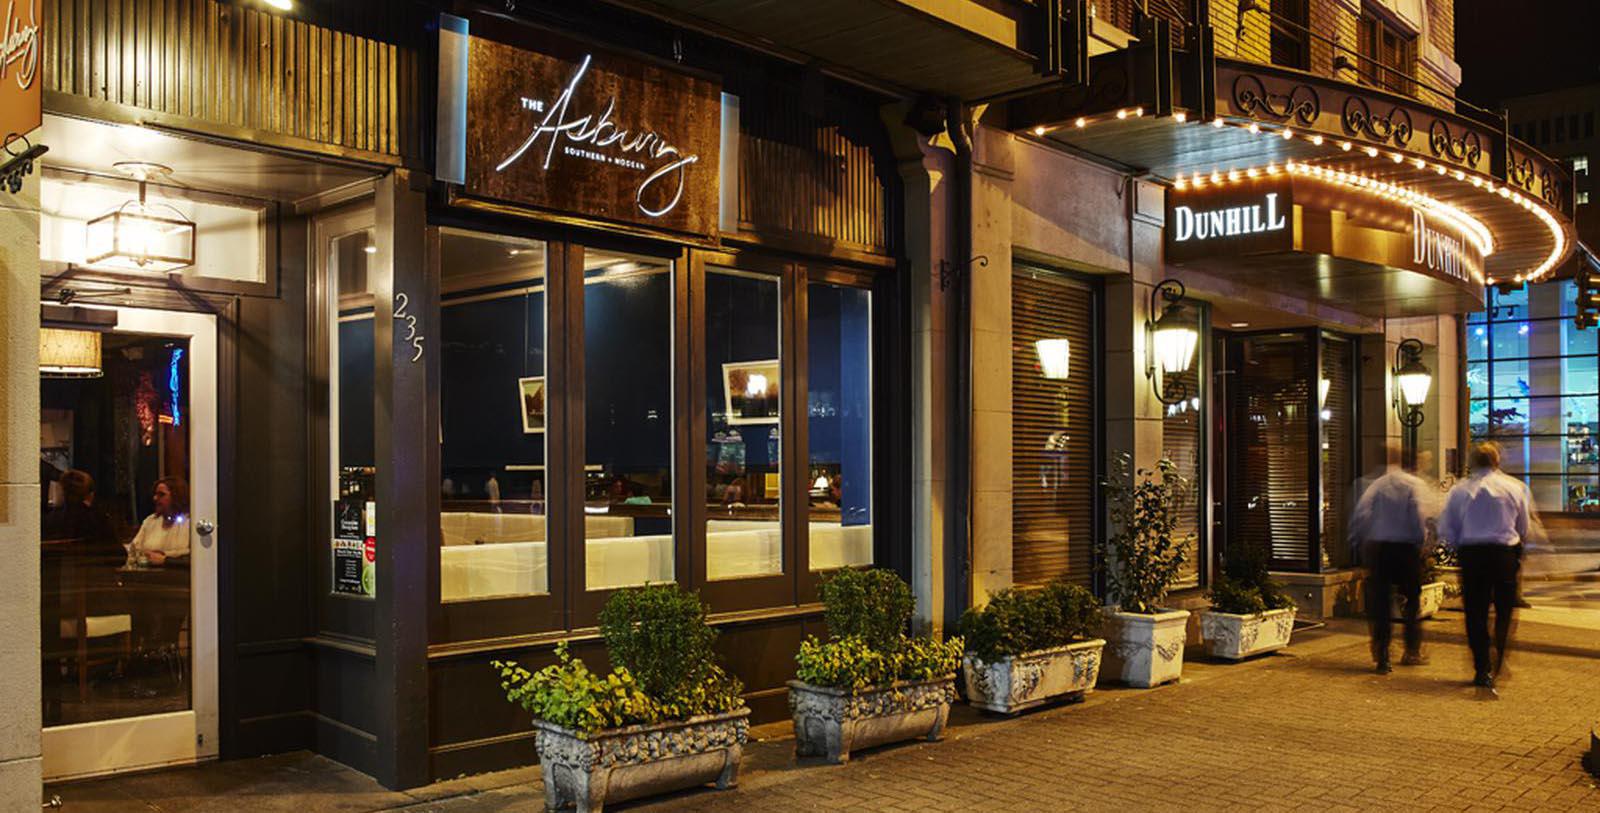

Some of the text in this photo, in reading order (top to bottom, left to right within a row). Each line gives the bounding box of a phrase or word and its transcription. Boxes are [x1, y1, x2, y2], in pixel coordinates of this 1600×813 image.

[497, 55, 698, 217] THE Asbury
[564, 146, 606, 162] SOUTHERN
[614, 157, 645, 170] MODERN
[392, 293, 424, 362] 235
